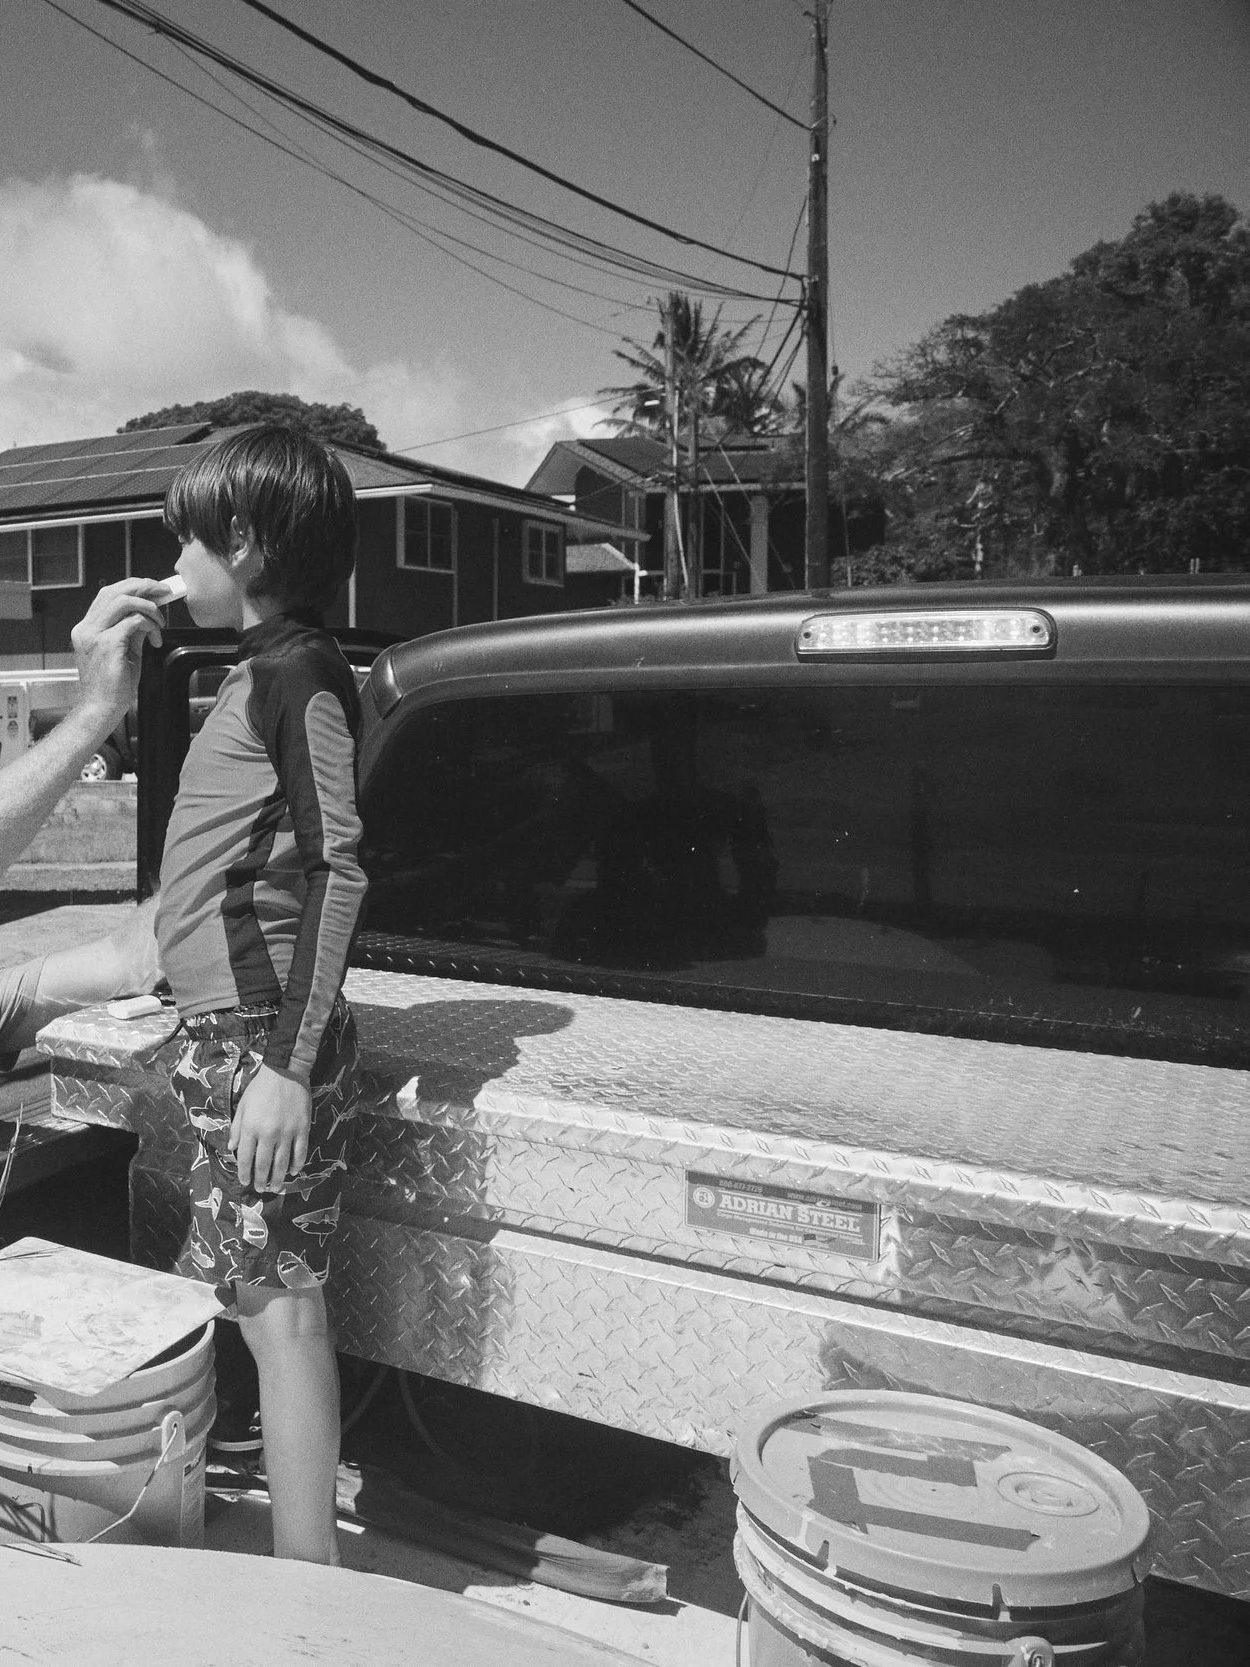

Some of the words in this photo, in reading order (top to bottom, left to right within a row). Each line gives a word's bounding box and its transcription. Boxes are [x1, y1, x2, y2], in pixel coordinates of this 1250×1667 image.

[719, 1194, 793, 1220] ADRIAN
[797, 1206, 860, 1233] STEEL
[749, 1227, 768, 1237] Made
[776, 1232, 788, 1241] the
[788, 1234, 802, 1244] USA
